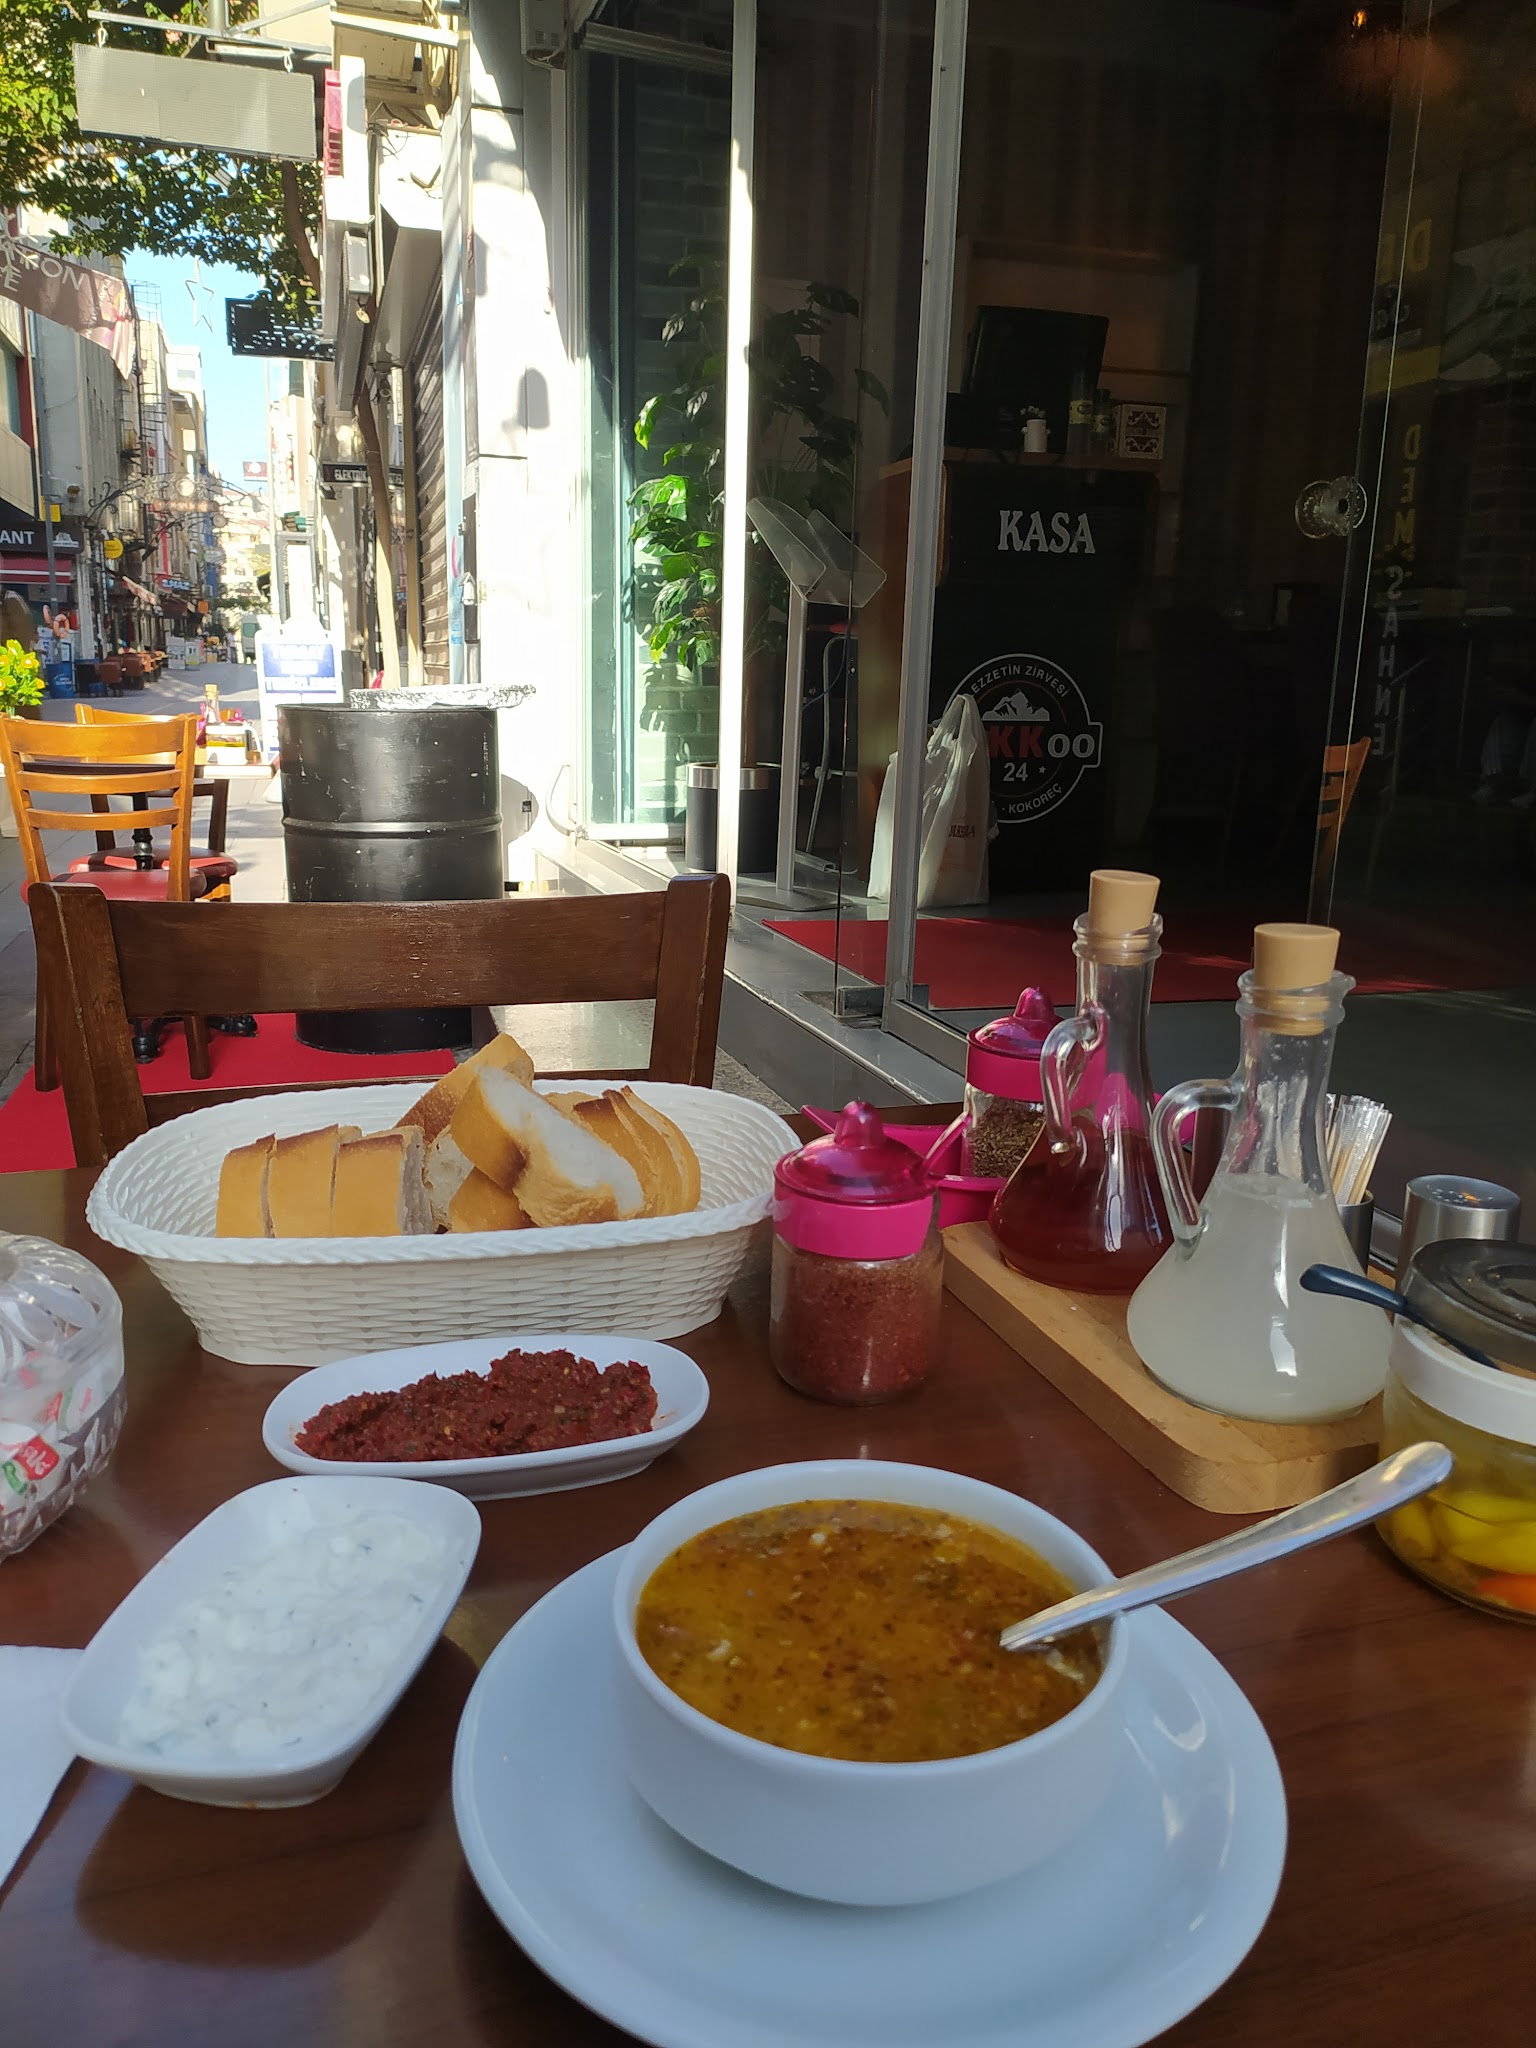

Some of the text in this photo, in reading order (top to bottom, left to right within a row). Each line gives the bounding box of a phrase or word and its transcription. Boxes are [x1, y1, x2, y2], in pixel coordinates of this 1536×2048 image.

[997, 510, 1096, 554] KASA
[971, 664, 1070, 698] EZZETİN ZİRVESİ
[1002, 762, 1029, 782] 24
[1008, 783, 1063, 814] KOKOREÇ
